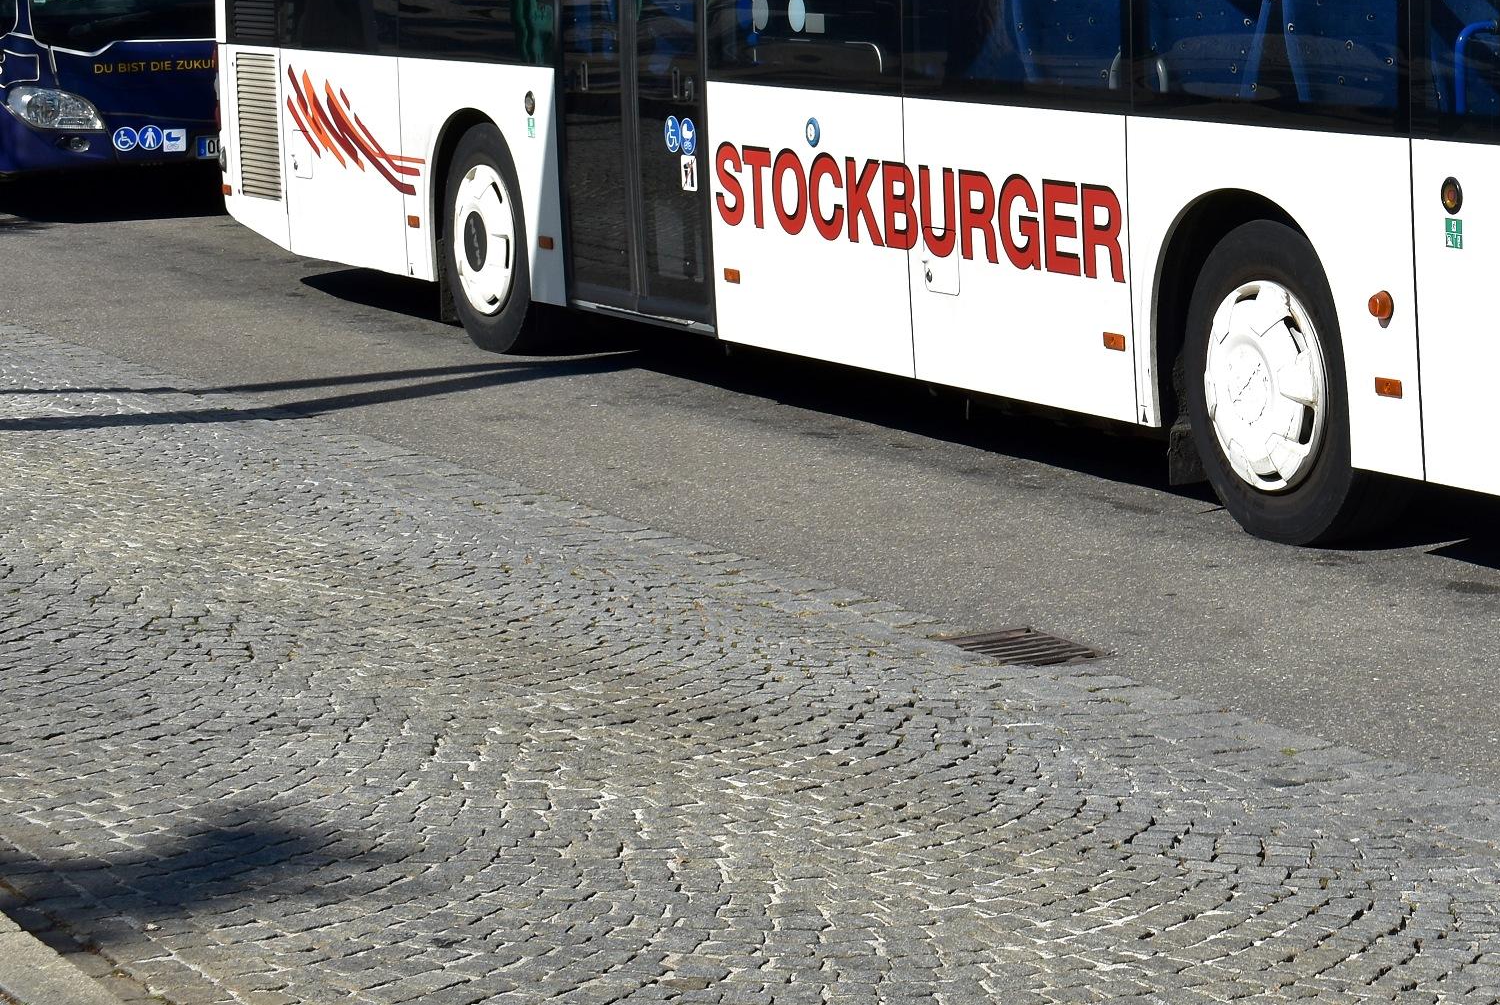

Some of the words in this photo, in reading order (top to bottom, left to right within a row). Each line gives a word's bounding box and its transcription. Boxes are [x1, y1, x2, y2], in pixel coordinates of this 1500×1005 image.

[94, 63, 113, 74] DU
[118, 62, 147, 73] BIST
[150, 60, 172, 72] DIE
[715, 140, 1127, 284] STOCKBURGER
